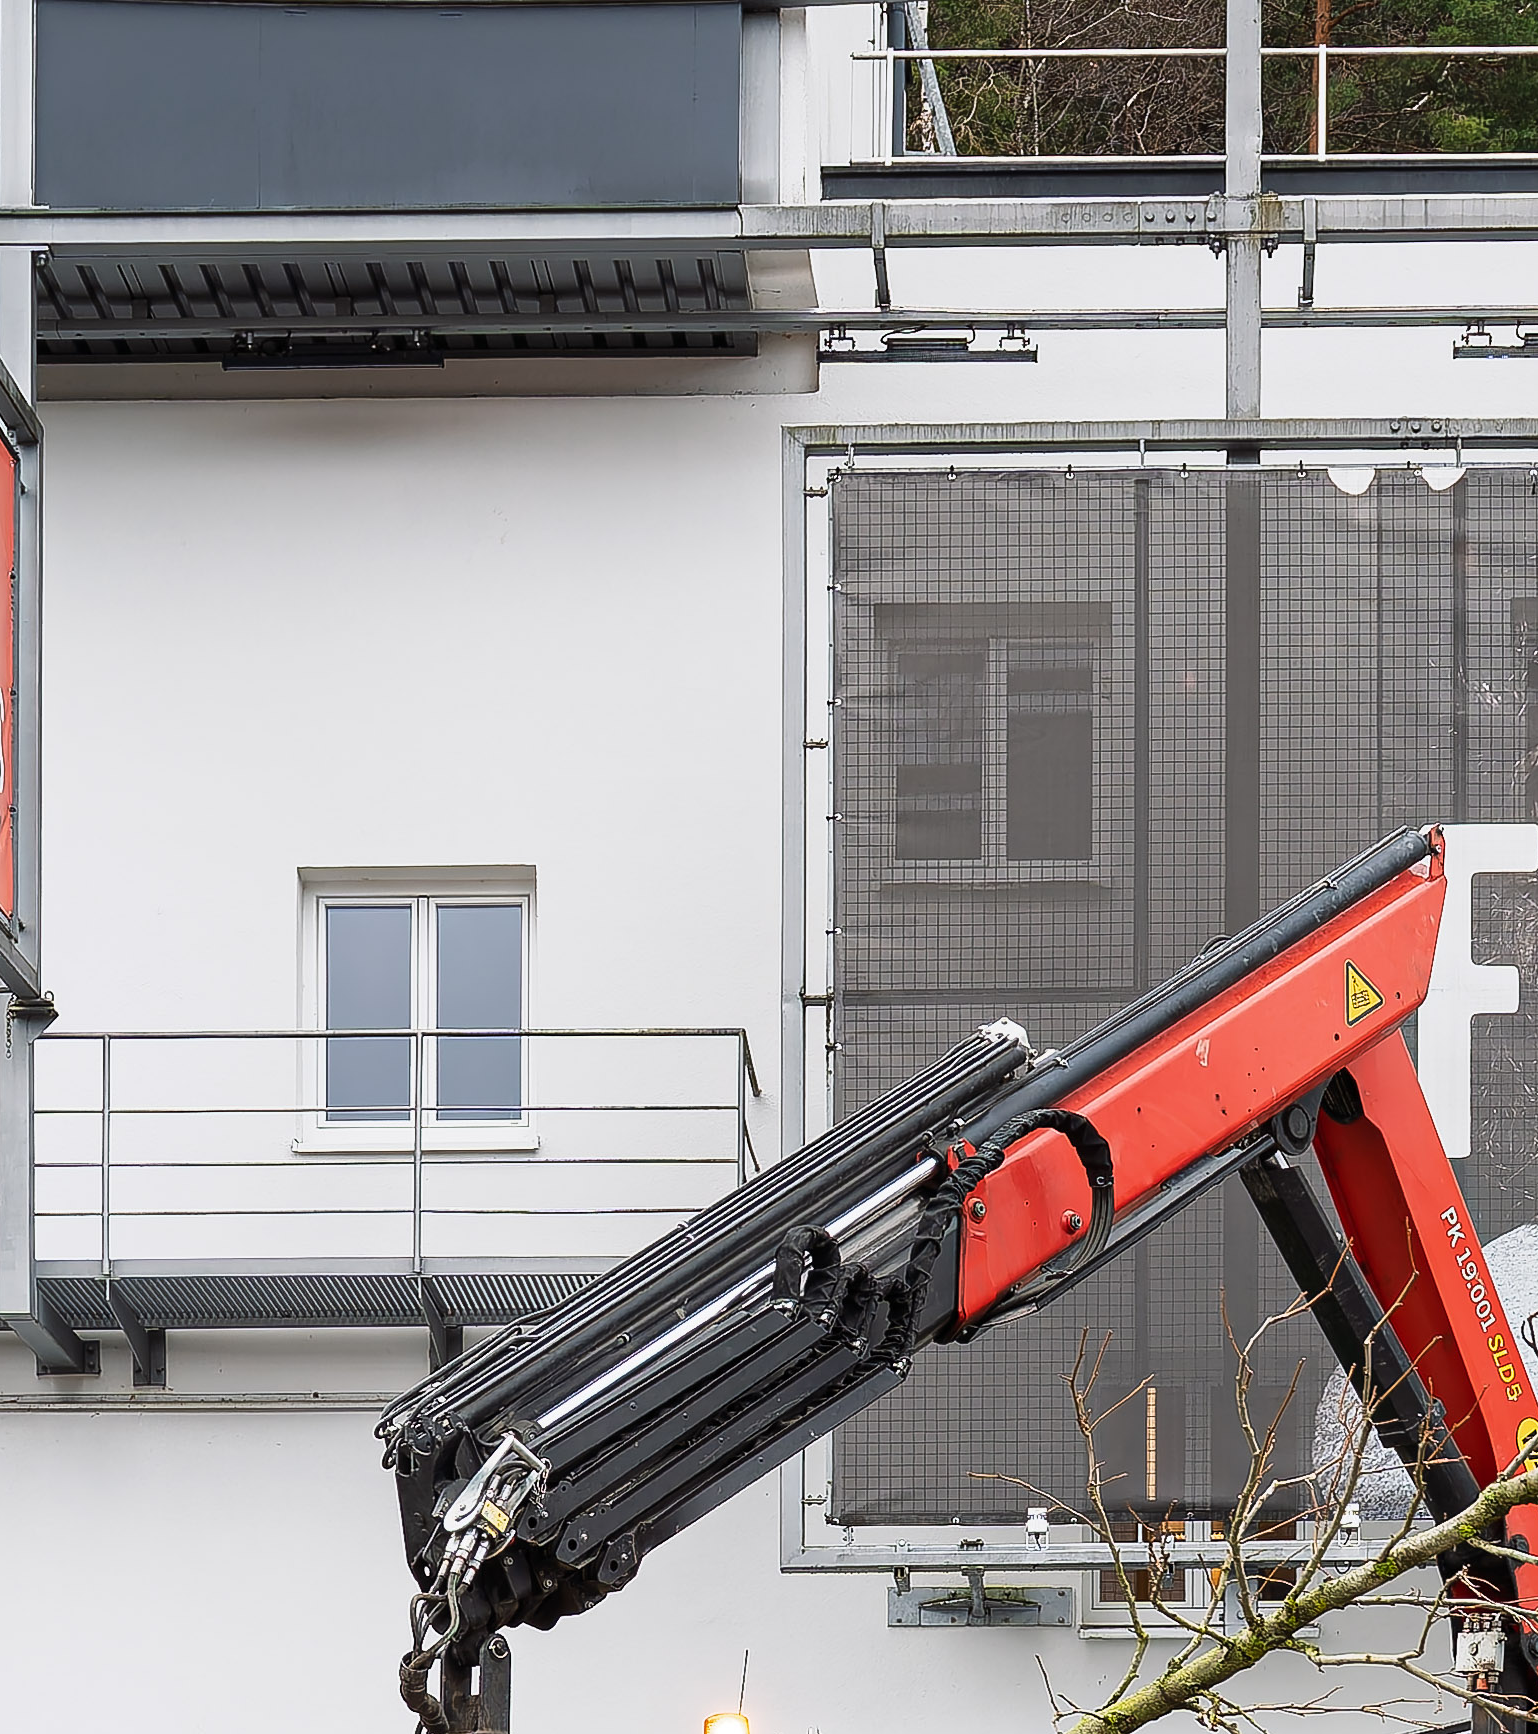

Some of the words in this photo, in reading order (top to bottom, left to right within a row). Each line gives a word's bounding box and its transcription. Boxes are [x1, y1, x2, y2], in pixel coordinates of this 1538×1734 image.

[1439, 1205, 1467, 1250] PK
[1456, 1250, 1496, 1334] 19.001
[1486, 1333, 1524, 1403] SLD5
